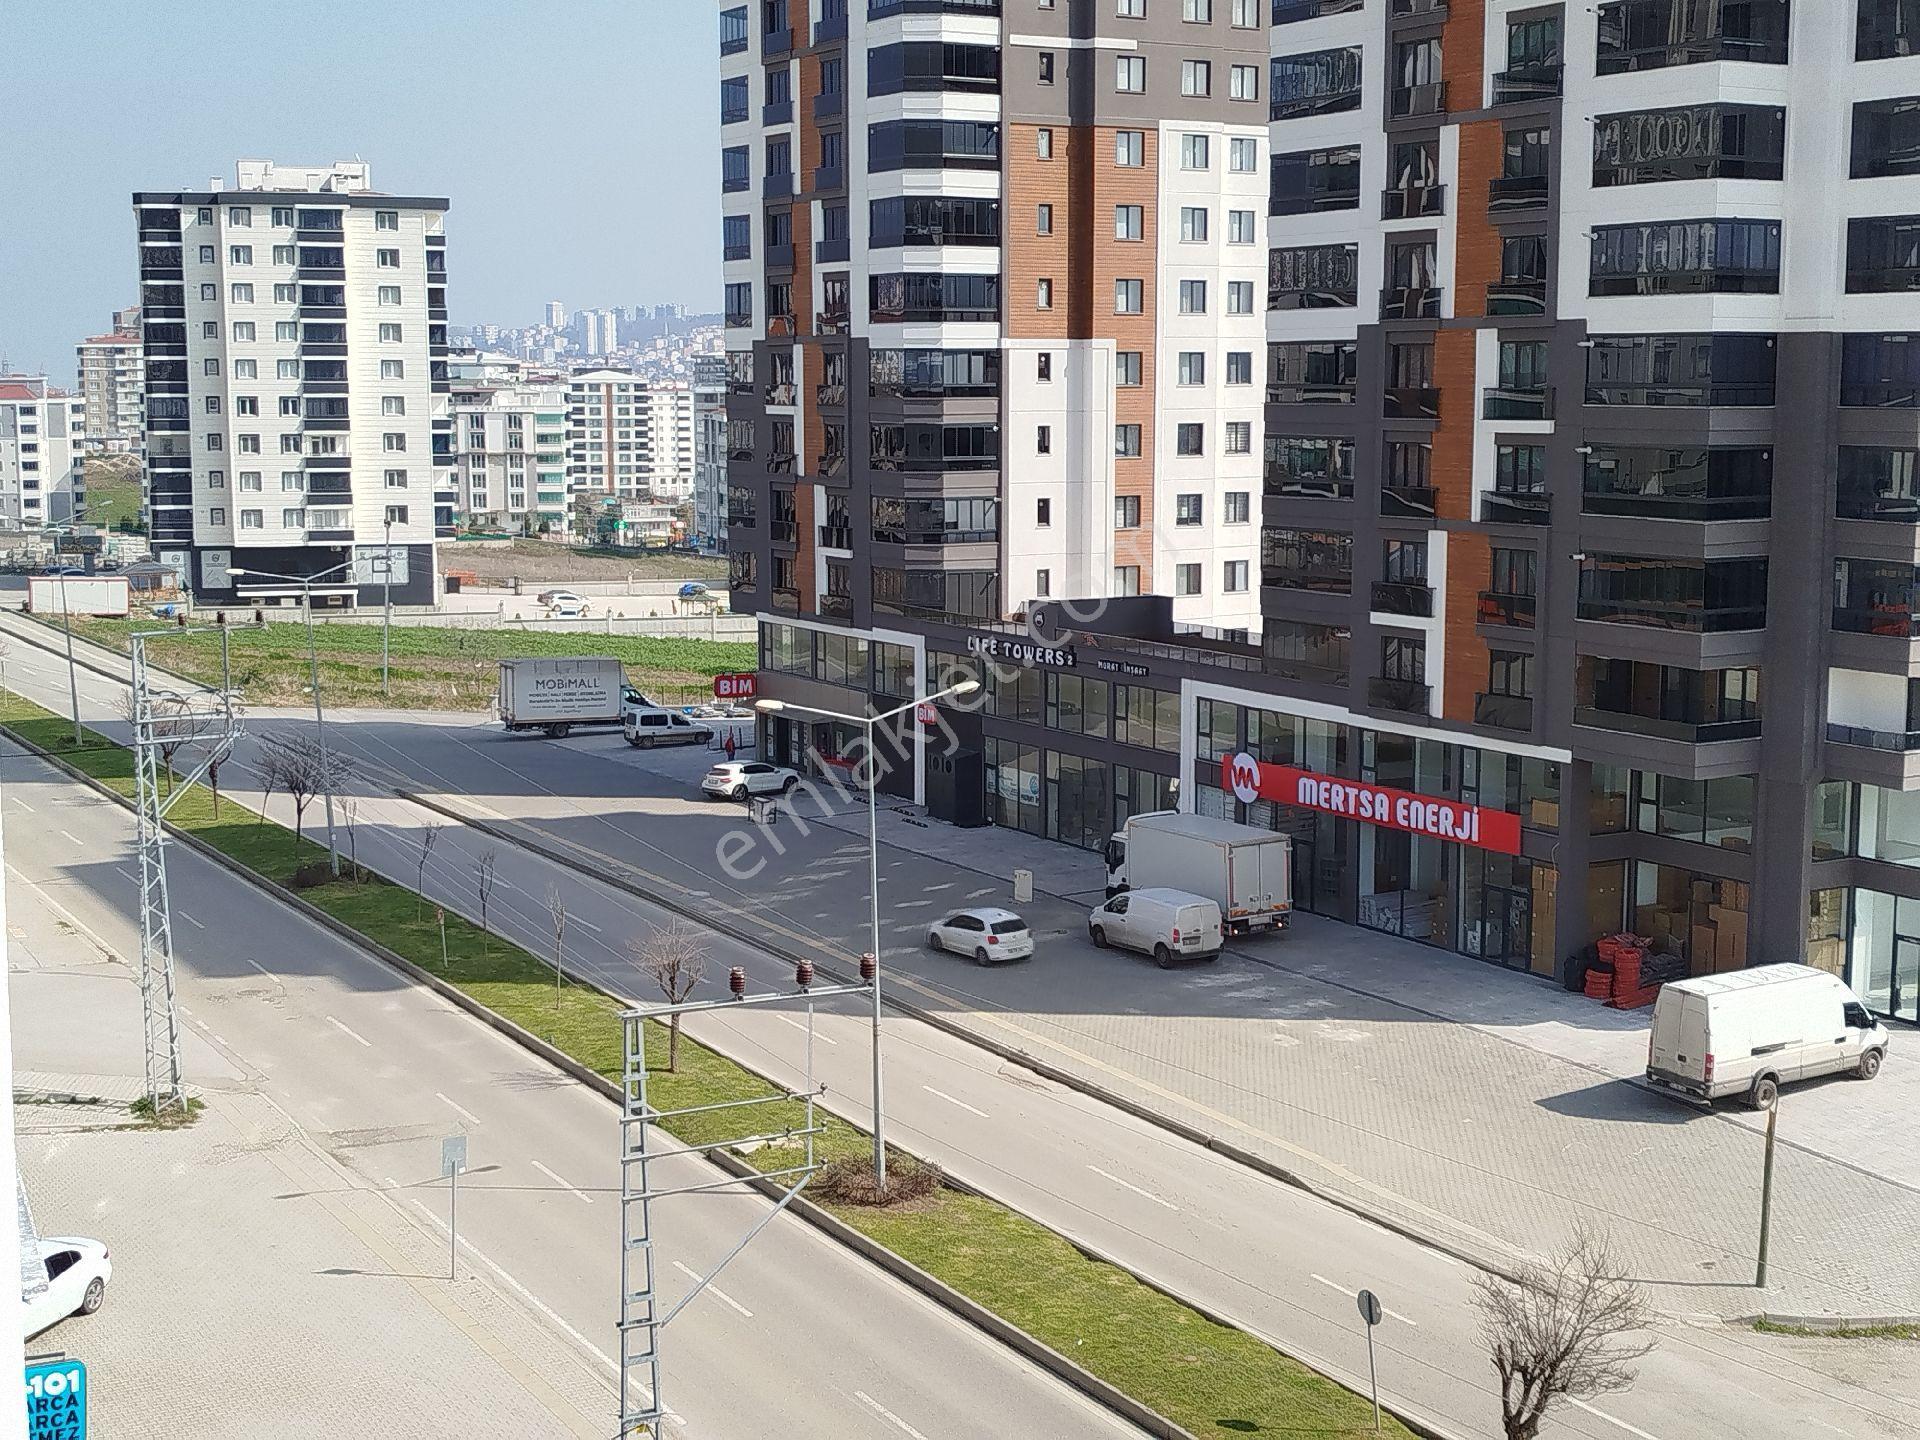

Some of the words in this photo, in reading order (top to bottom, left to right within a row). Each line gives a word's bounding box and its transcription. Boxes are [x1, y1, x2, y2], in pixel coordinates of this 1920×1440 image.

[967, 636, 998, 655] LIFE
[1003, 642, 1064, 666] TOWERS
[1297, 777, 1389, 823] MERTSA
[1396, 797, 1480, 842] ENERJİ
